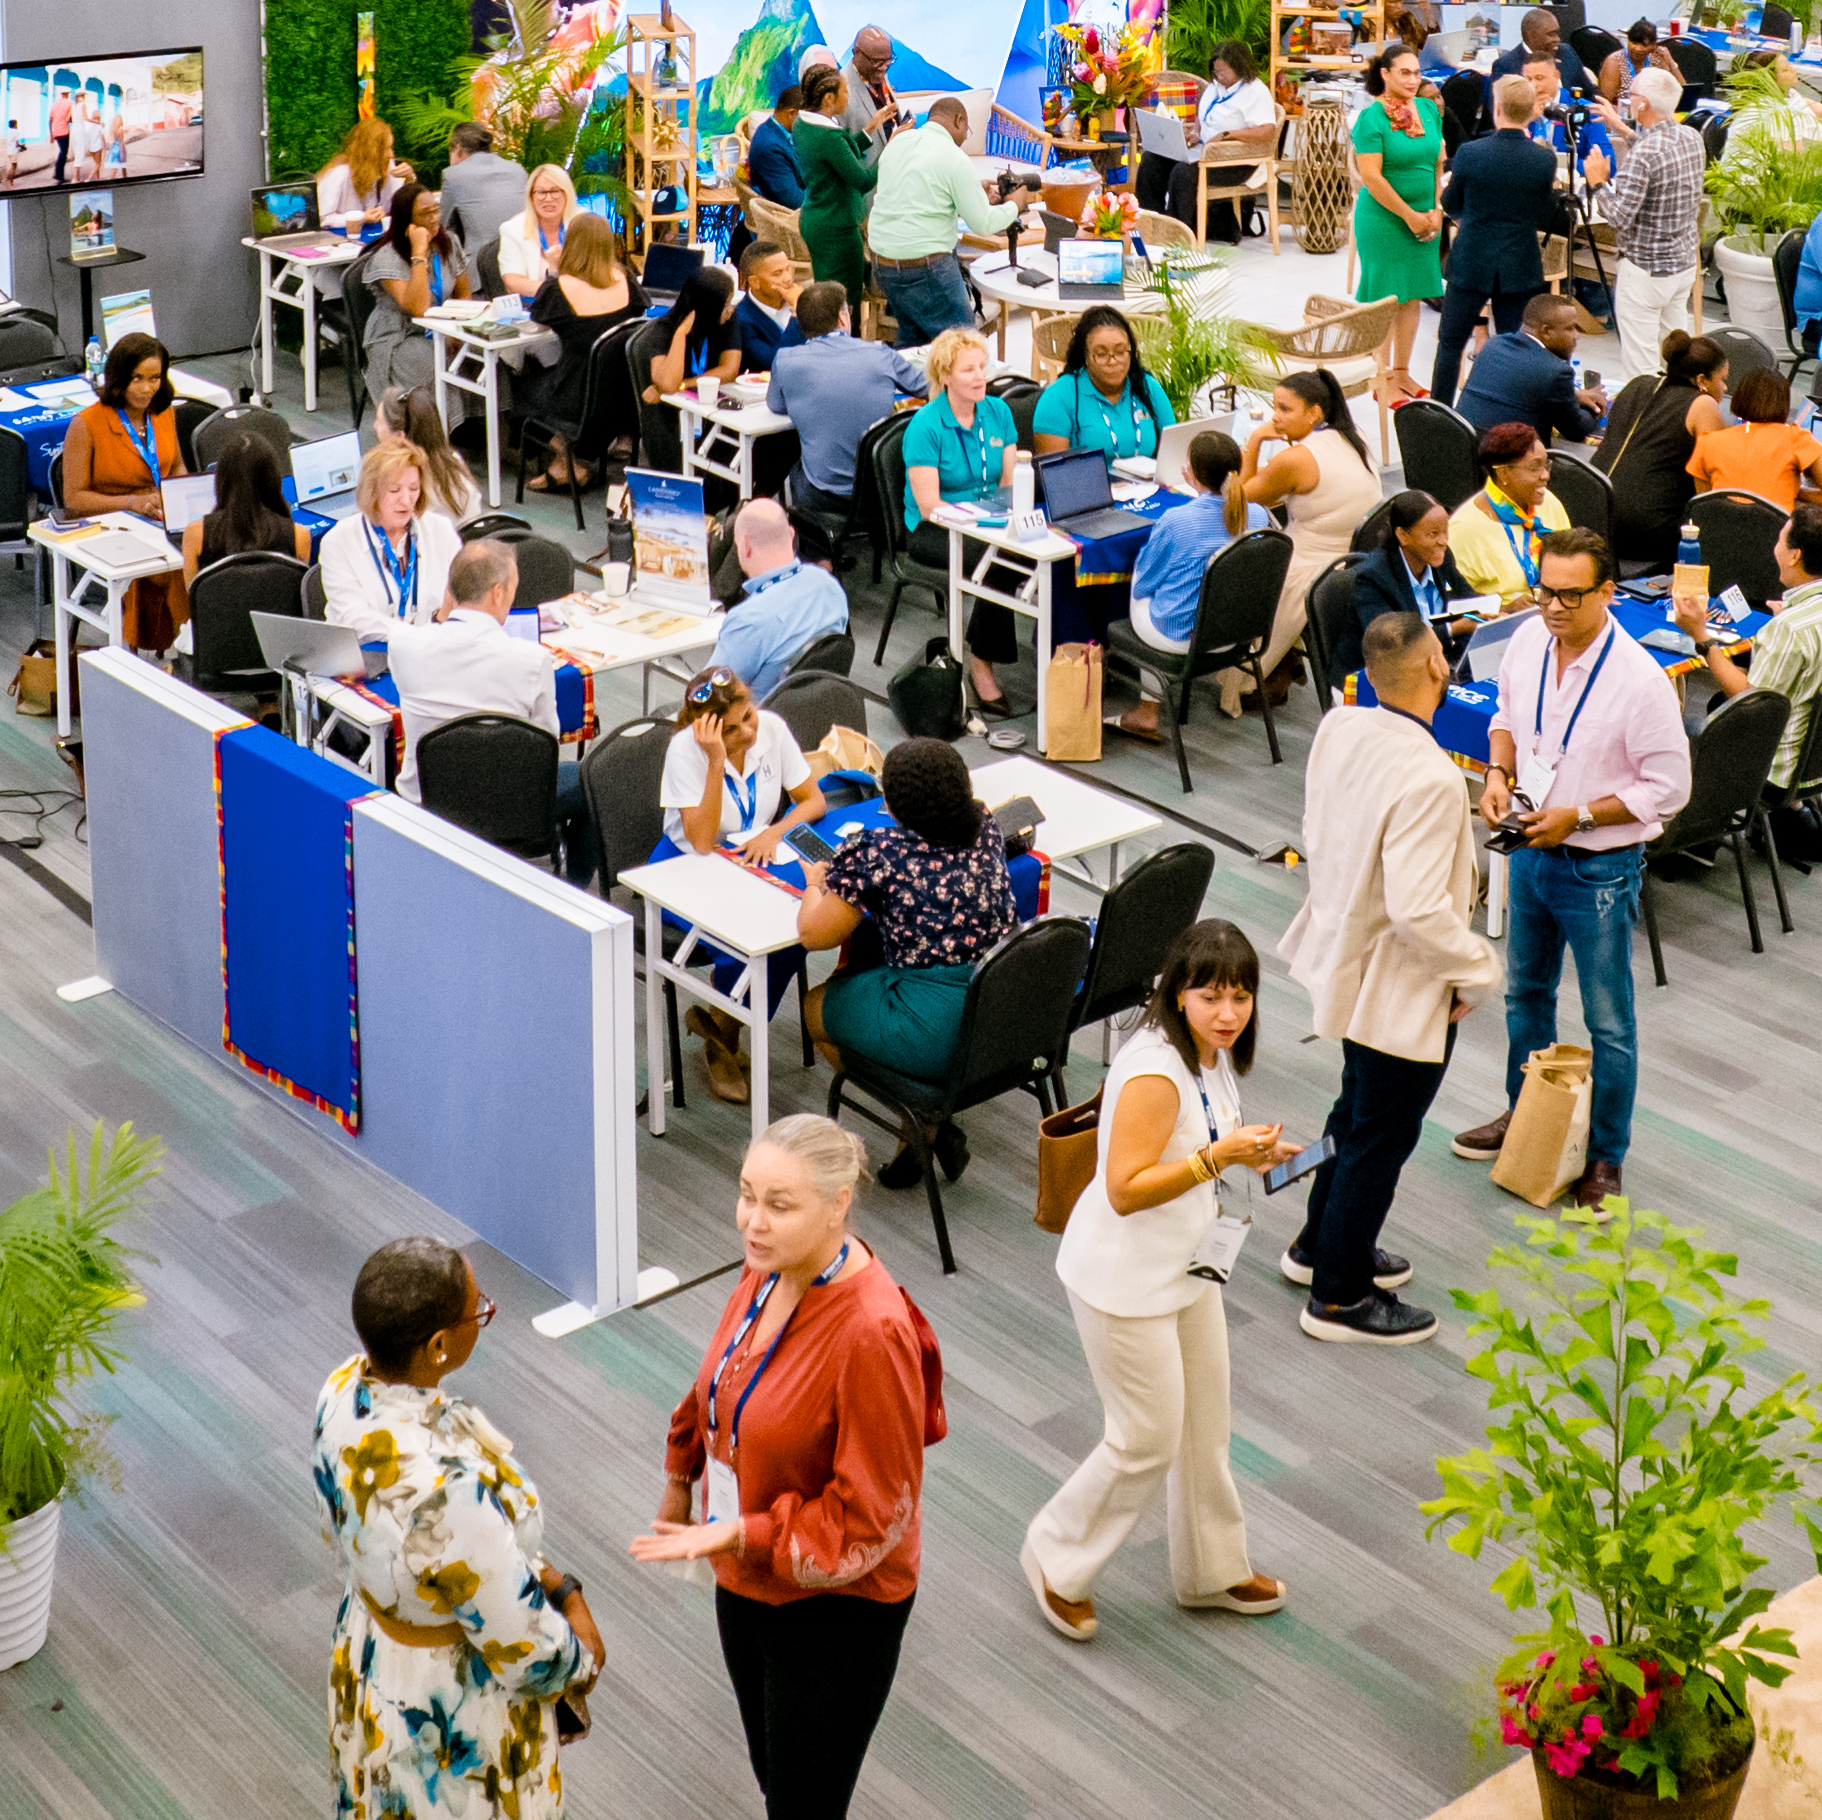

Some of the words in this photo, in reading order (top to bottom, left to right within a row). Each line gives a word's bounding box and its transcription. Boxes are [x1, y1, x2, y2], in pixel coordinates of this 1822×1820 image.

[501, 297, 520, 310] 113
[1022, 513, 1045, 530] 115
[1725, 588, 1745, 606] 116
